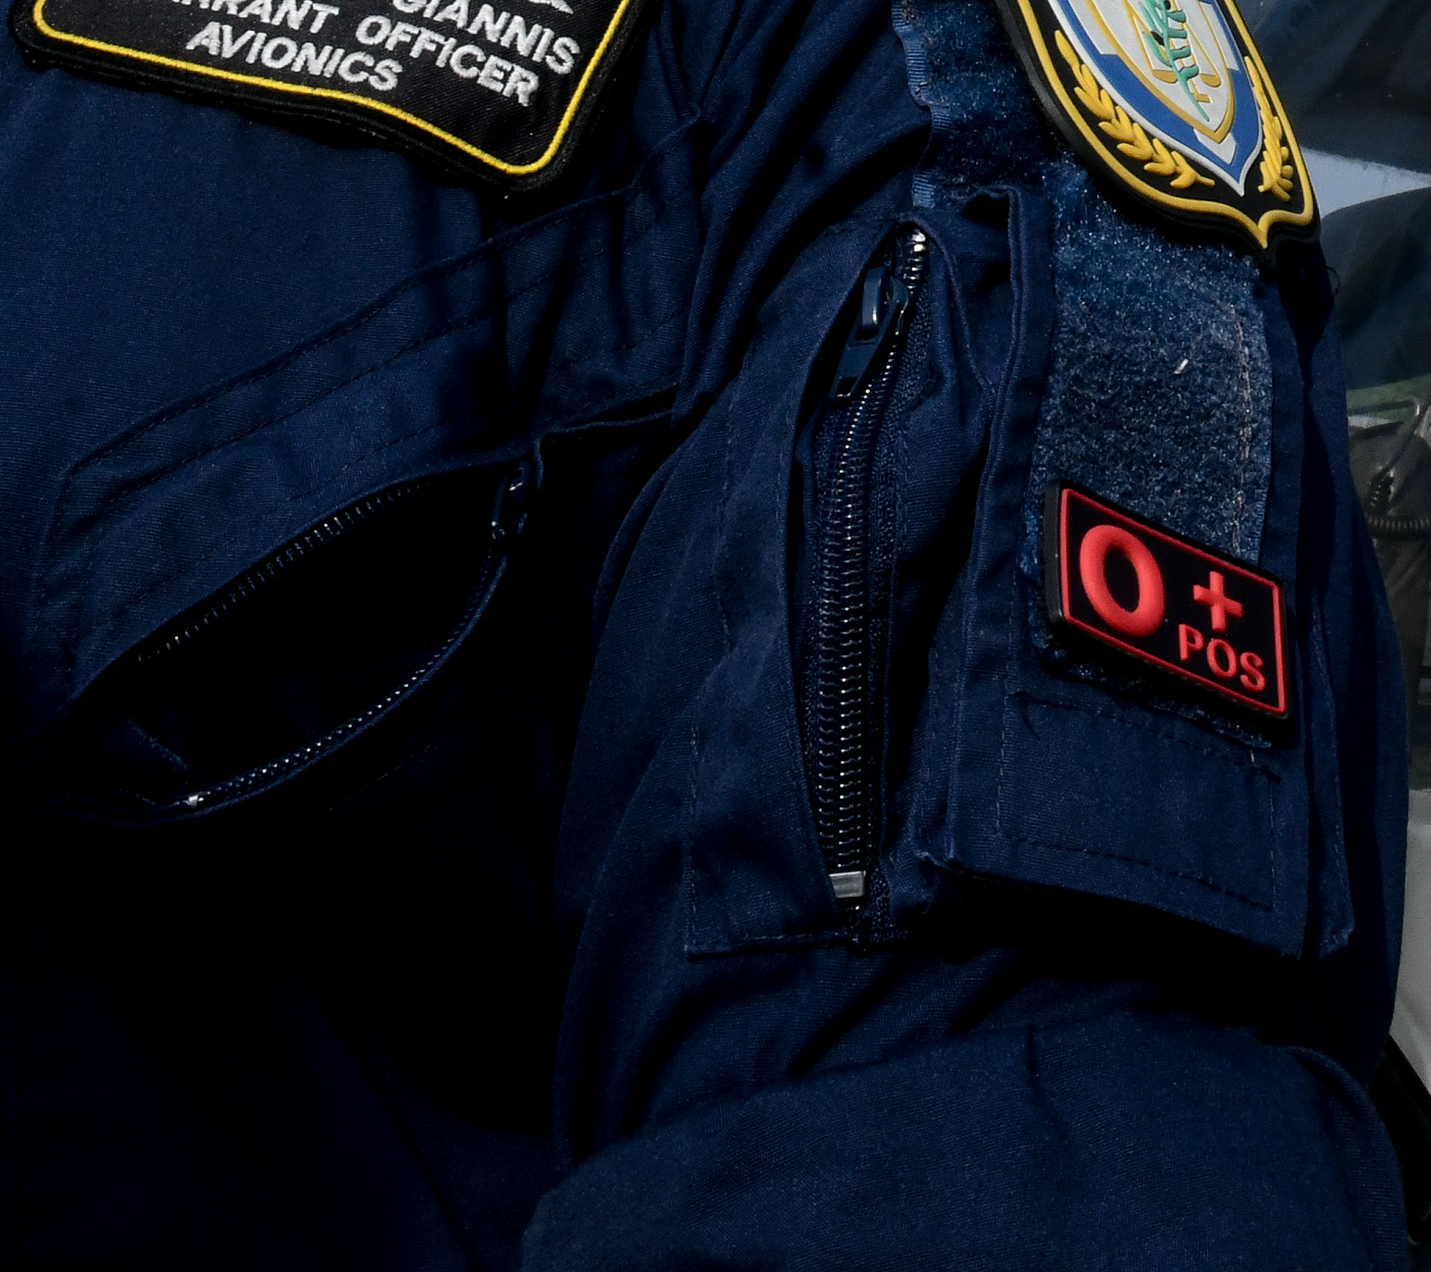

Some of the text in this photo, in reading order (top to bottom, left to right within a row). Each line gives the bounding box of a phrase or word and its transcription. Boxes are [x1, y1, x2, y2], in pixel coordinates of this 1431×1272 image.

[187, 21, 404, 92] AVIONICS
[355, 14, 539, 107] OFFICER
[1178, 624, 1265, 692] POS
